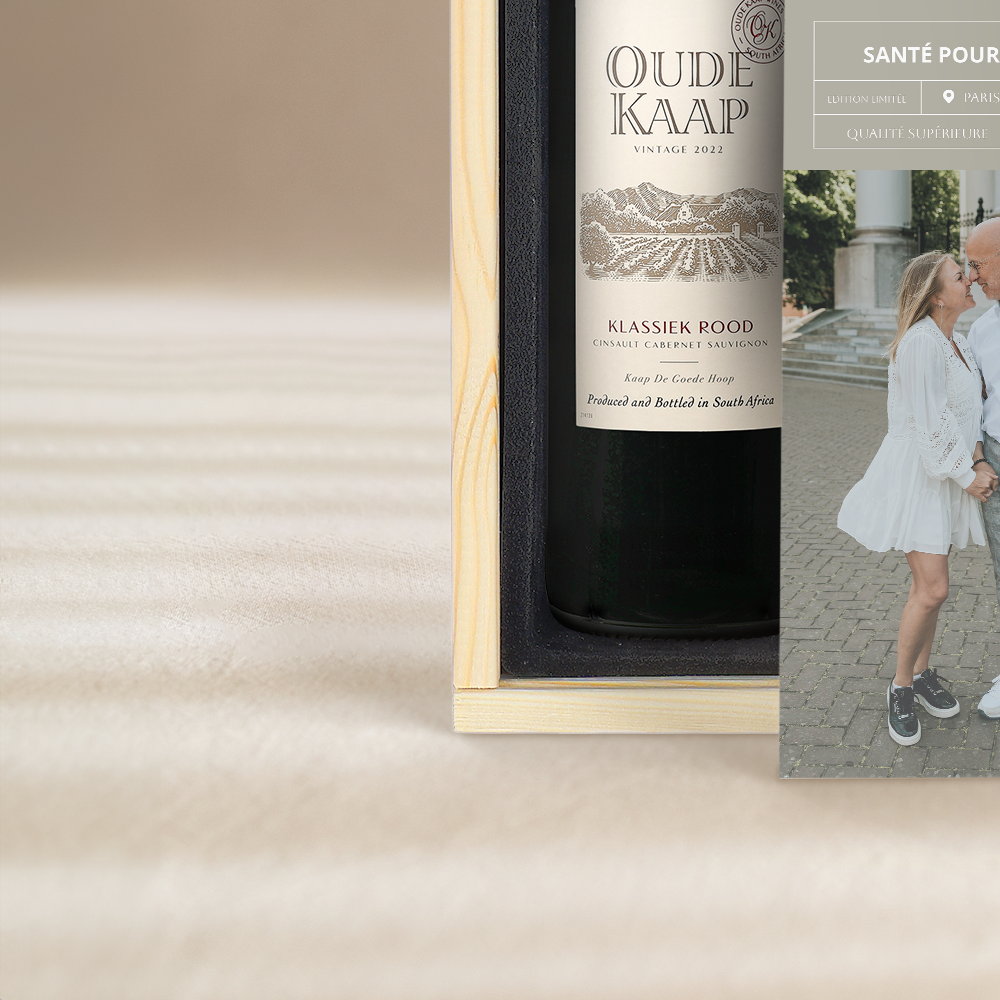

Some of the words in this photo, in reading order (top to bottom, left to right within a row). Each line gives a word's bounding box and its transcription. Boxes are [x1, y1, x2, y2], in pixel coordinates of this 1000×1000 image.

[863, 42, 932, 64] SANTÉ
[939, 46, 1000, 64] POUR
[606, 45, 754, 88] OUDE
[964, 92, 1000, 103] PARIS
[610, 92, 750, 135] KAAP
[847, 126, 905, 142] QUALITÉ
[908, 125, 988, 139] SUPÉRIEURE
[634, 145, 688, 154] VINTAGE
[694, 145, 724, 154] 2022
[608, 319, 692, 335] KLASSIEK
[699, 319, 754, 335] ROOD
[592, 338, 639, 348] CINSAULT
[644, 340, 702, 349] CABERNET
[707, 339, 769, 349] SAUVIGNON
[624, 373, 651, 386] Kaap
[654, 373, 669, 384] De
[672, 373, 705, 384] Goede
[707, 373, 735, 386] Hoop
[587, 393, 630, 407] Produced
[631, 395, 652, 408] and
[654, 396, 695, 408] Bottled
[697, 396, 709, 408] in
[713, 395, 744, 408] South
[745, 394, 775, 409] Africa
